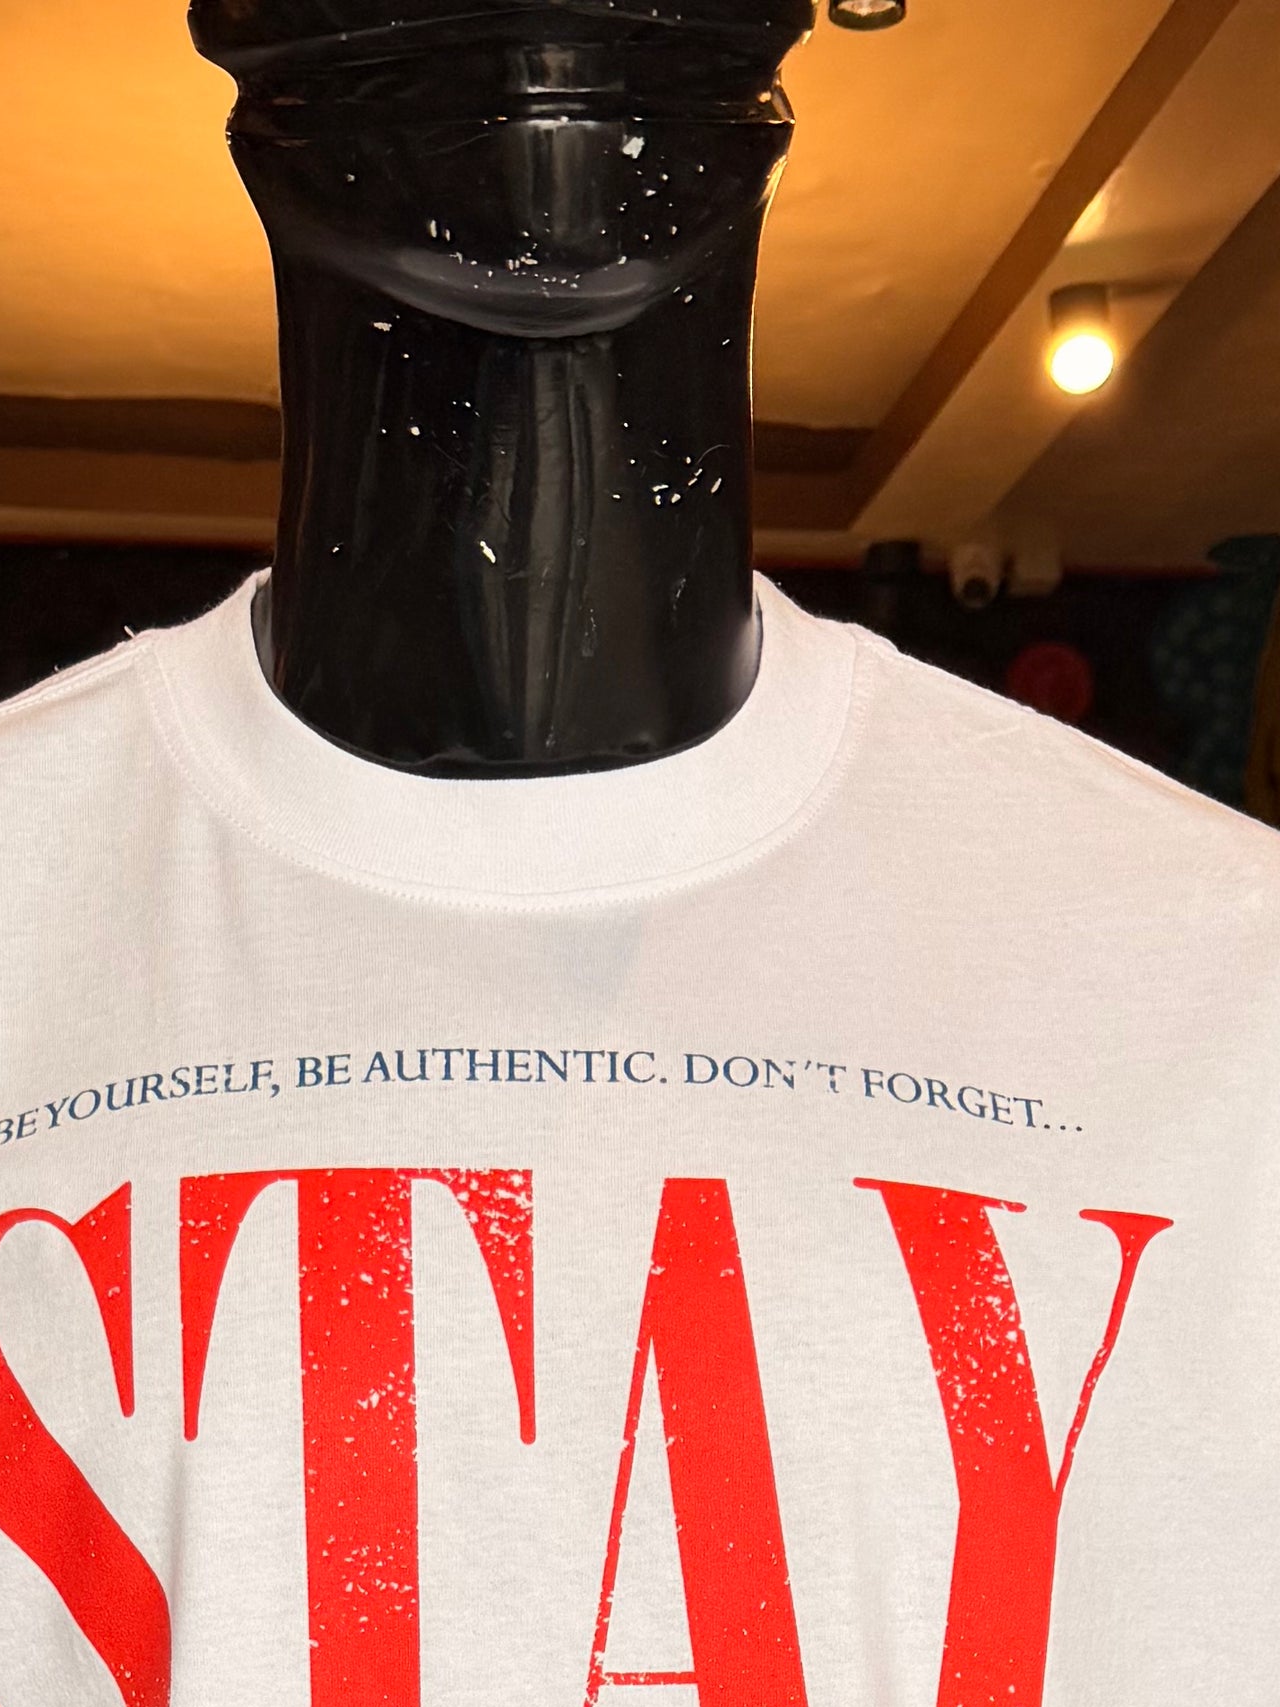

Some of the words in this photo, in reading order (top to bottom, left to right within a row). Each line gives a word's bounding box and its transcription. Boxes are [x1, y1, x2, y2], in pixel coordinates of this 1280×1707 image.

[43, 1060, 281, 1129] YOURSELF,
[295, 1053, 352, 1088] BE
[361, 1047, 668, 1084] AUTHENTIC.
[683, 1053, 846, 1094] DON'T
[860, 1067, 1084, 1133] FORGET...
